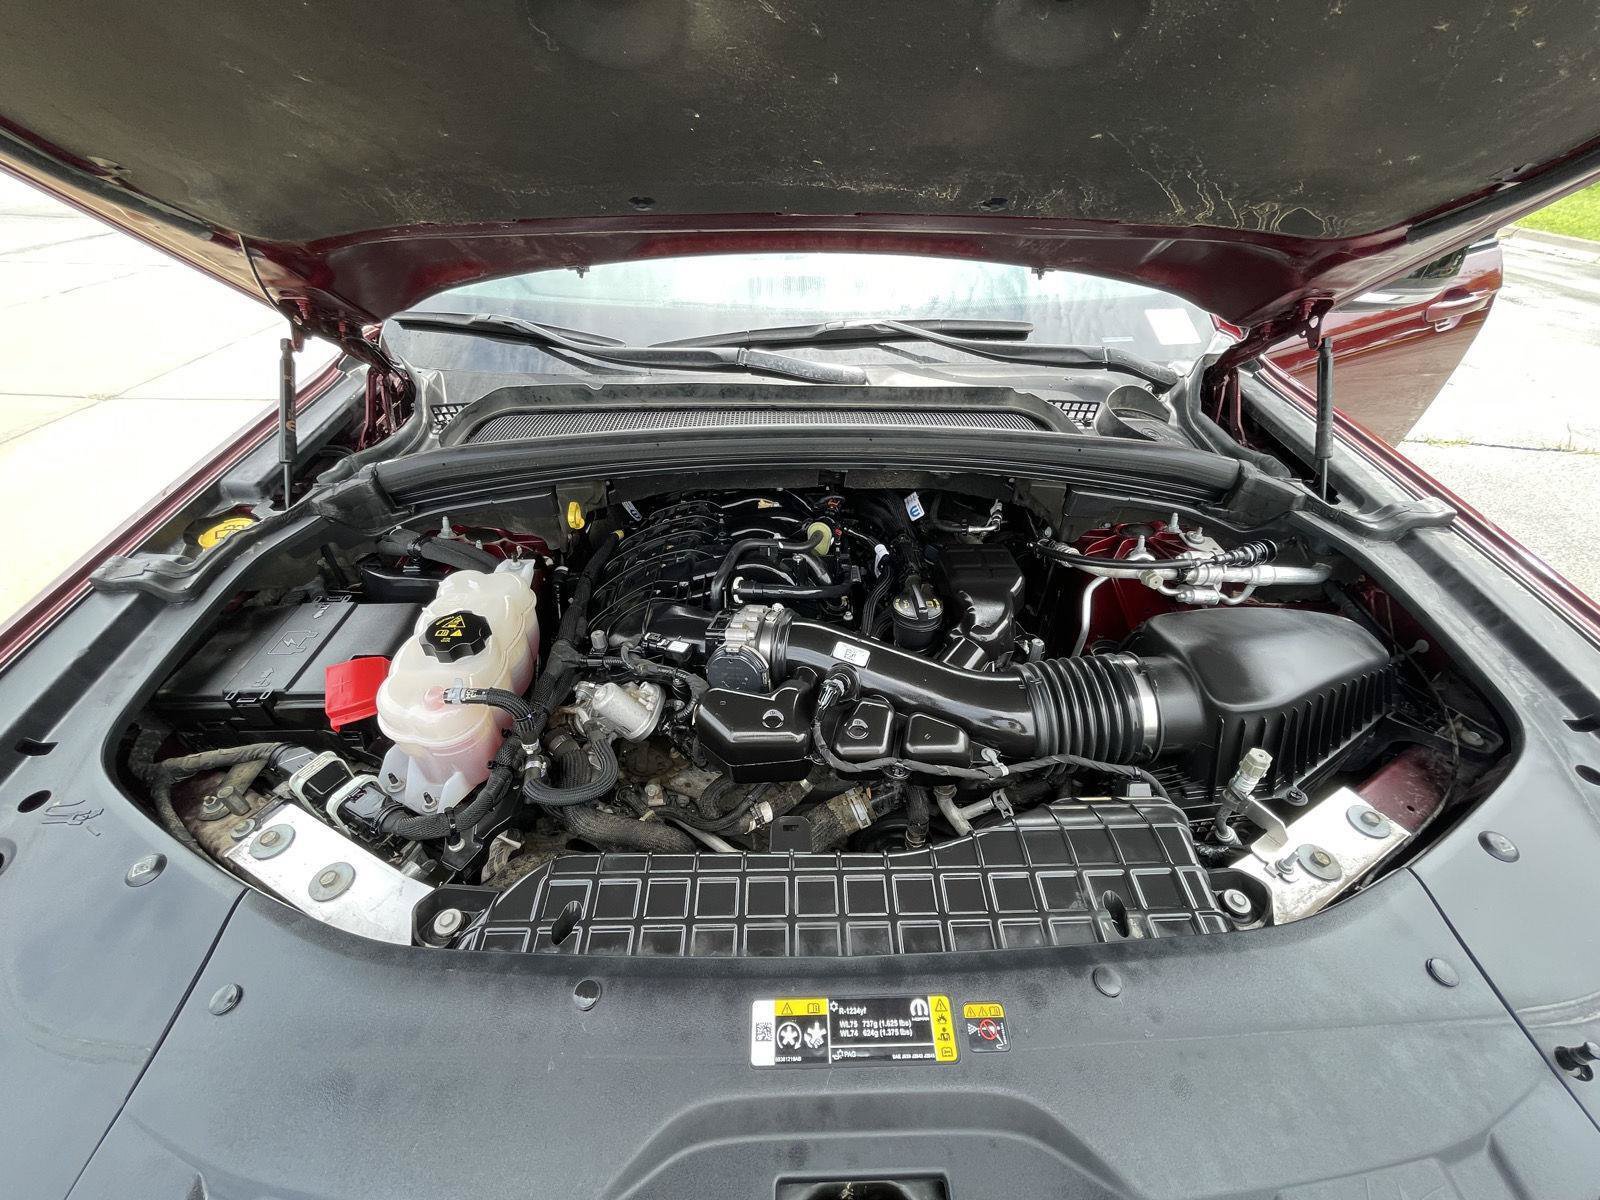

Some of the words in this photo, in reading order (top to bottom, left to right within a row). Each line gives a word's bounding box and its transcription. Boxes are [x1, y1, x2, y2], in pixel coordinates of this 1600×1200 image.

[838, 1006, 867, 1016] R-1234yf
[861, 1020, 878, 1029] 737g
[899, 1019, 912, 1028] lbs)
[862, 1029, 879, 1038] 624g
[880, 1028, 899, 1037] (1.375
[900, 1028, 913, 1037] lbs)
